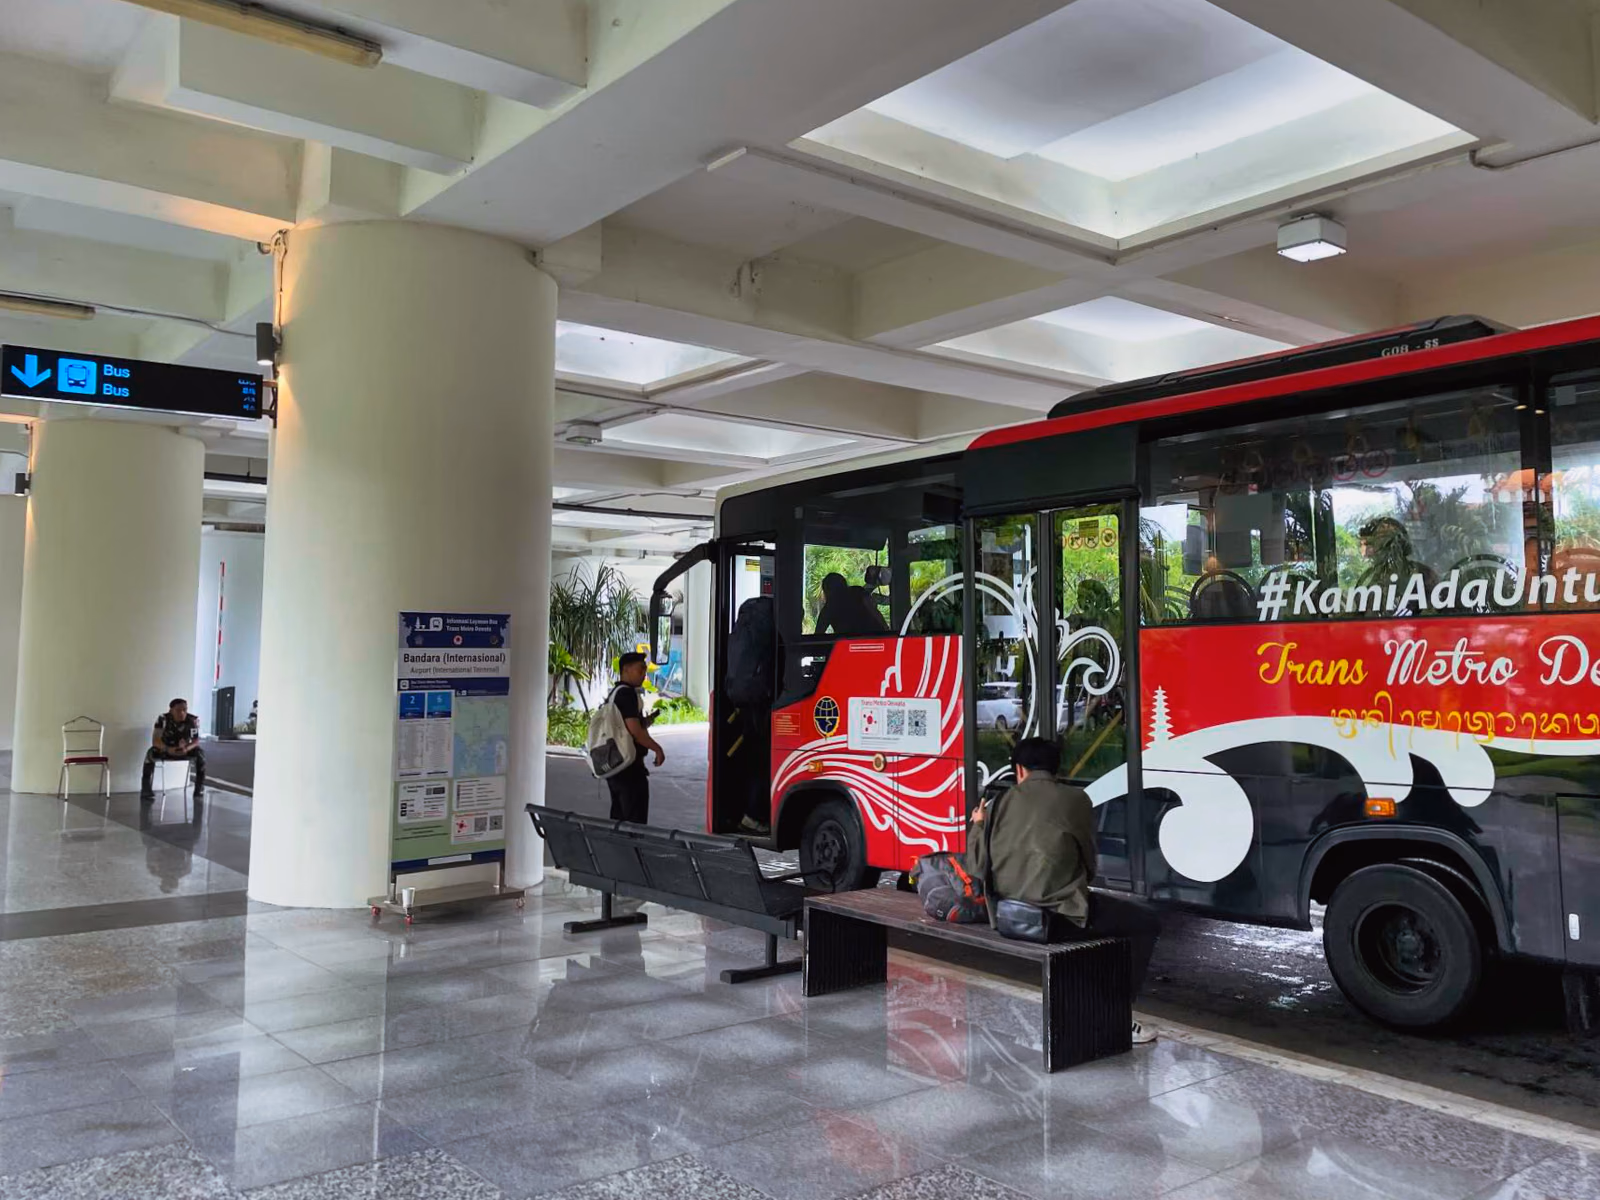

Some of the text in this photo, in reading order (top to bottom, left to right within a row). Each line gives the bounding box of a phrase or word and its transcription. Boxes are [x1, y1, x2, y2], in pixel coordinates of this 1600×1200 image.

[103, 364, 130, 378] Bus
[103, 383, 130, 397] Bus
[403, 652, 506, 665] Bandara (Internasional)
[1257, 641, 1368, 685] Trans
[1384, 637, 1518, 686] Metro
[410, 695, 415, 704] 2
